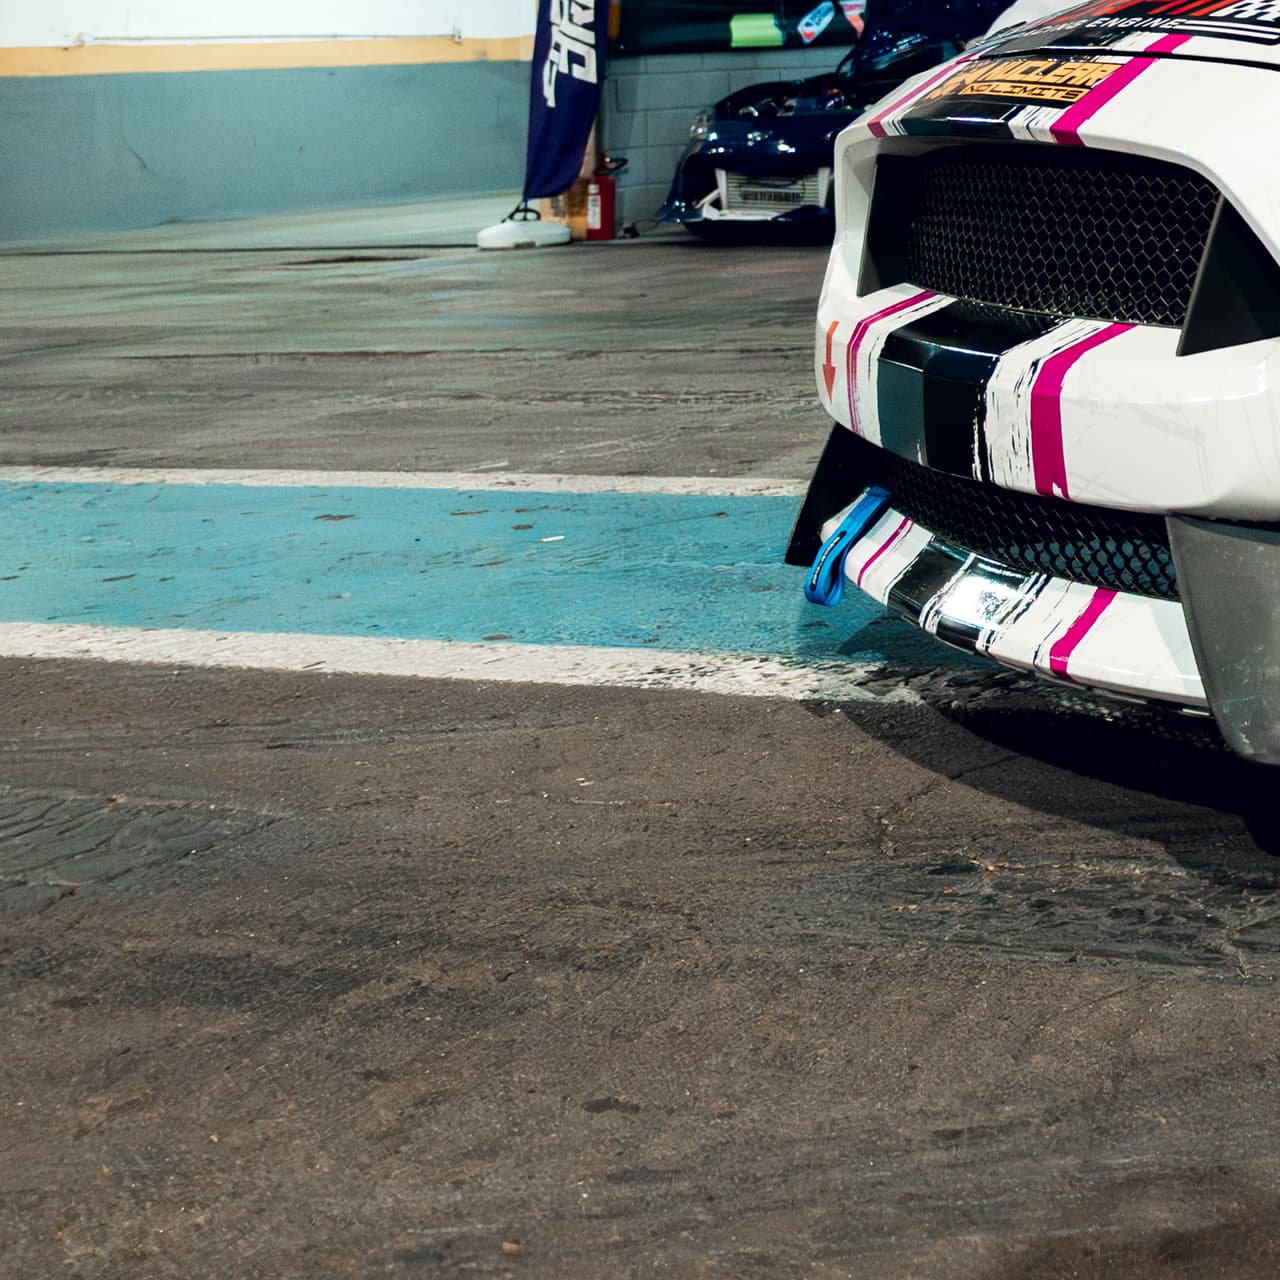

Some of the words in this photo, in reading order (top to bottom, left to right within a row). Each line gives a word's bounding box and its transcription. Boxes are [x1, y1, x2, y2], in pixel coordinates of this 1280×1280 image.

[1085, 17, 1185, 29] ENGINE
[978, 59, 1124, 89] NUCLEAR
[993, 85, 1084, 99] LIMITS
